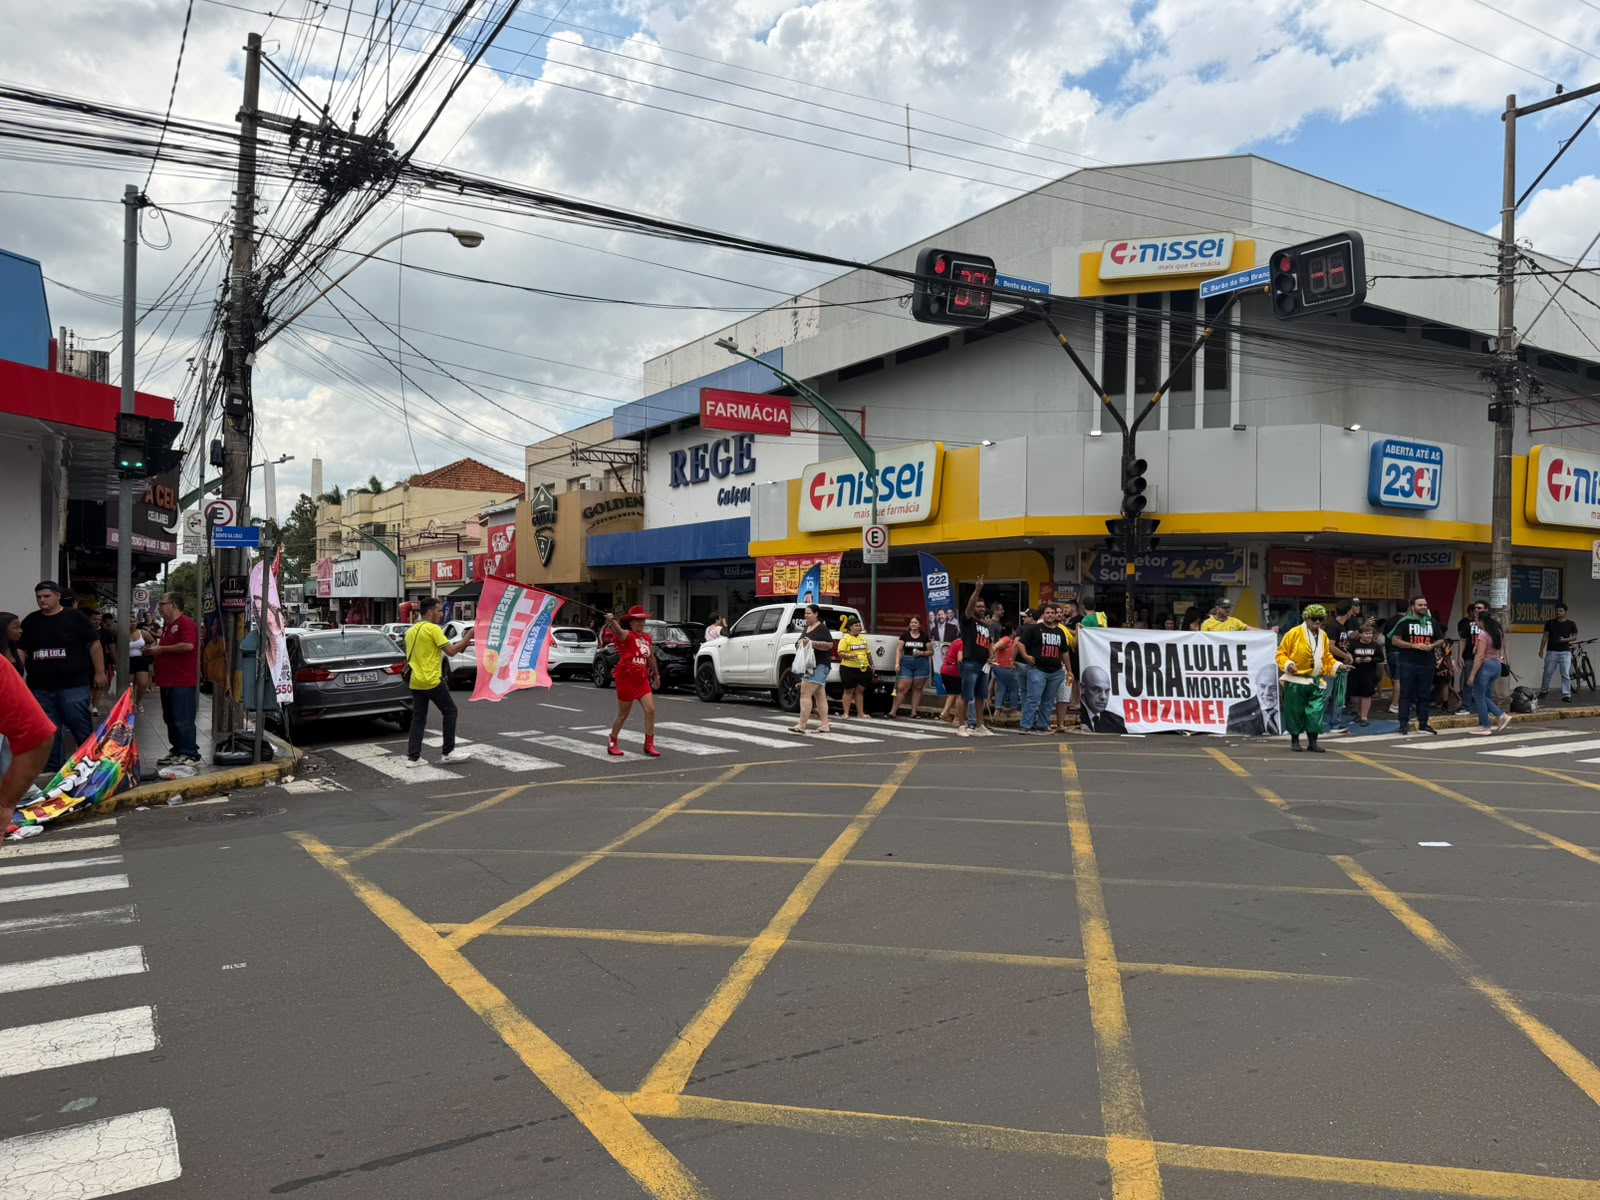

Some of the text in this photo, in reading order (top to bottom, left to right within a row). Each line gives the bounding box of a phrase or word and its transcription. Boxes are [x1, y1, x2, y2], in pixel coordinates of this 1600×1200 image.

[1139, 239, 1224, 263] nissei
[1238, 276, 1250, 284] Rio
[1250, 270, 1270, 281] Branc
[1003, 280, 1019, 289] Bento
[1028, 285, 1041, 293] Cruz
[706, 401, 789, 424] FARMÁCIA
[669, 432, 756, 488] REGE
[1385, 444, 1414, 457] ABERTA
[1415, 447, 1429, 460] ATÉ
[836, 461, 924, 507] nissei
[1573, 467, 1600, 505] ni
[716, 482, 755, 507] Calça
[212, 507, 225, 519] E
[582, 496, 645, 519] GOLDEN
[853, 509, 870, 519] mais
[886, 502, 920, 515] farmácia
[871, 531, 879, 544] E
[1100, 553, 1225, 580] Proetor 24,90
[1100, 568, 1142, 581] Solr
[928, 575, 947, 586] 222
[1409, 623, 1433, 636] FORA
[1041, 632, 1061, 646] FORA
[50, 649, 66, 658] LULA
[1041, 645, 1060, 659] LULA
[1109, 641, 1247, 698] FORA LULA E
[1186, 677, 1251, 698] MORAES
[1123, 699, 1225, 724] BUZINE!
